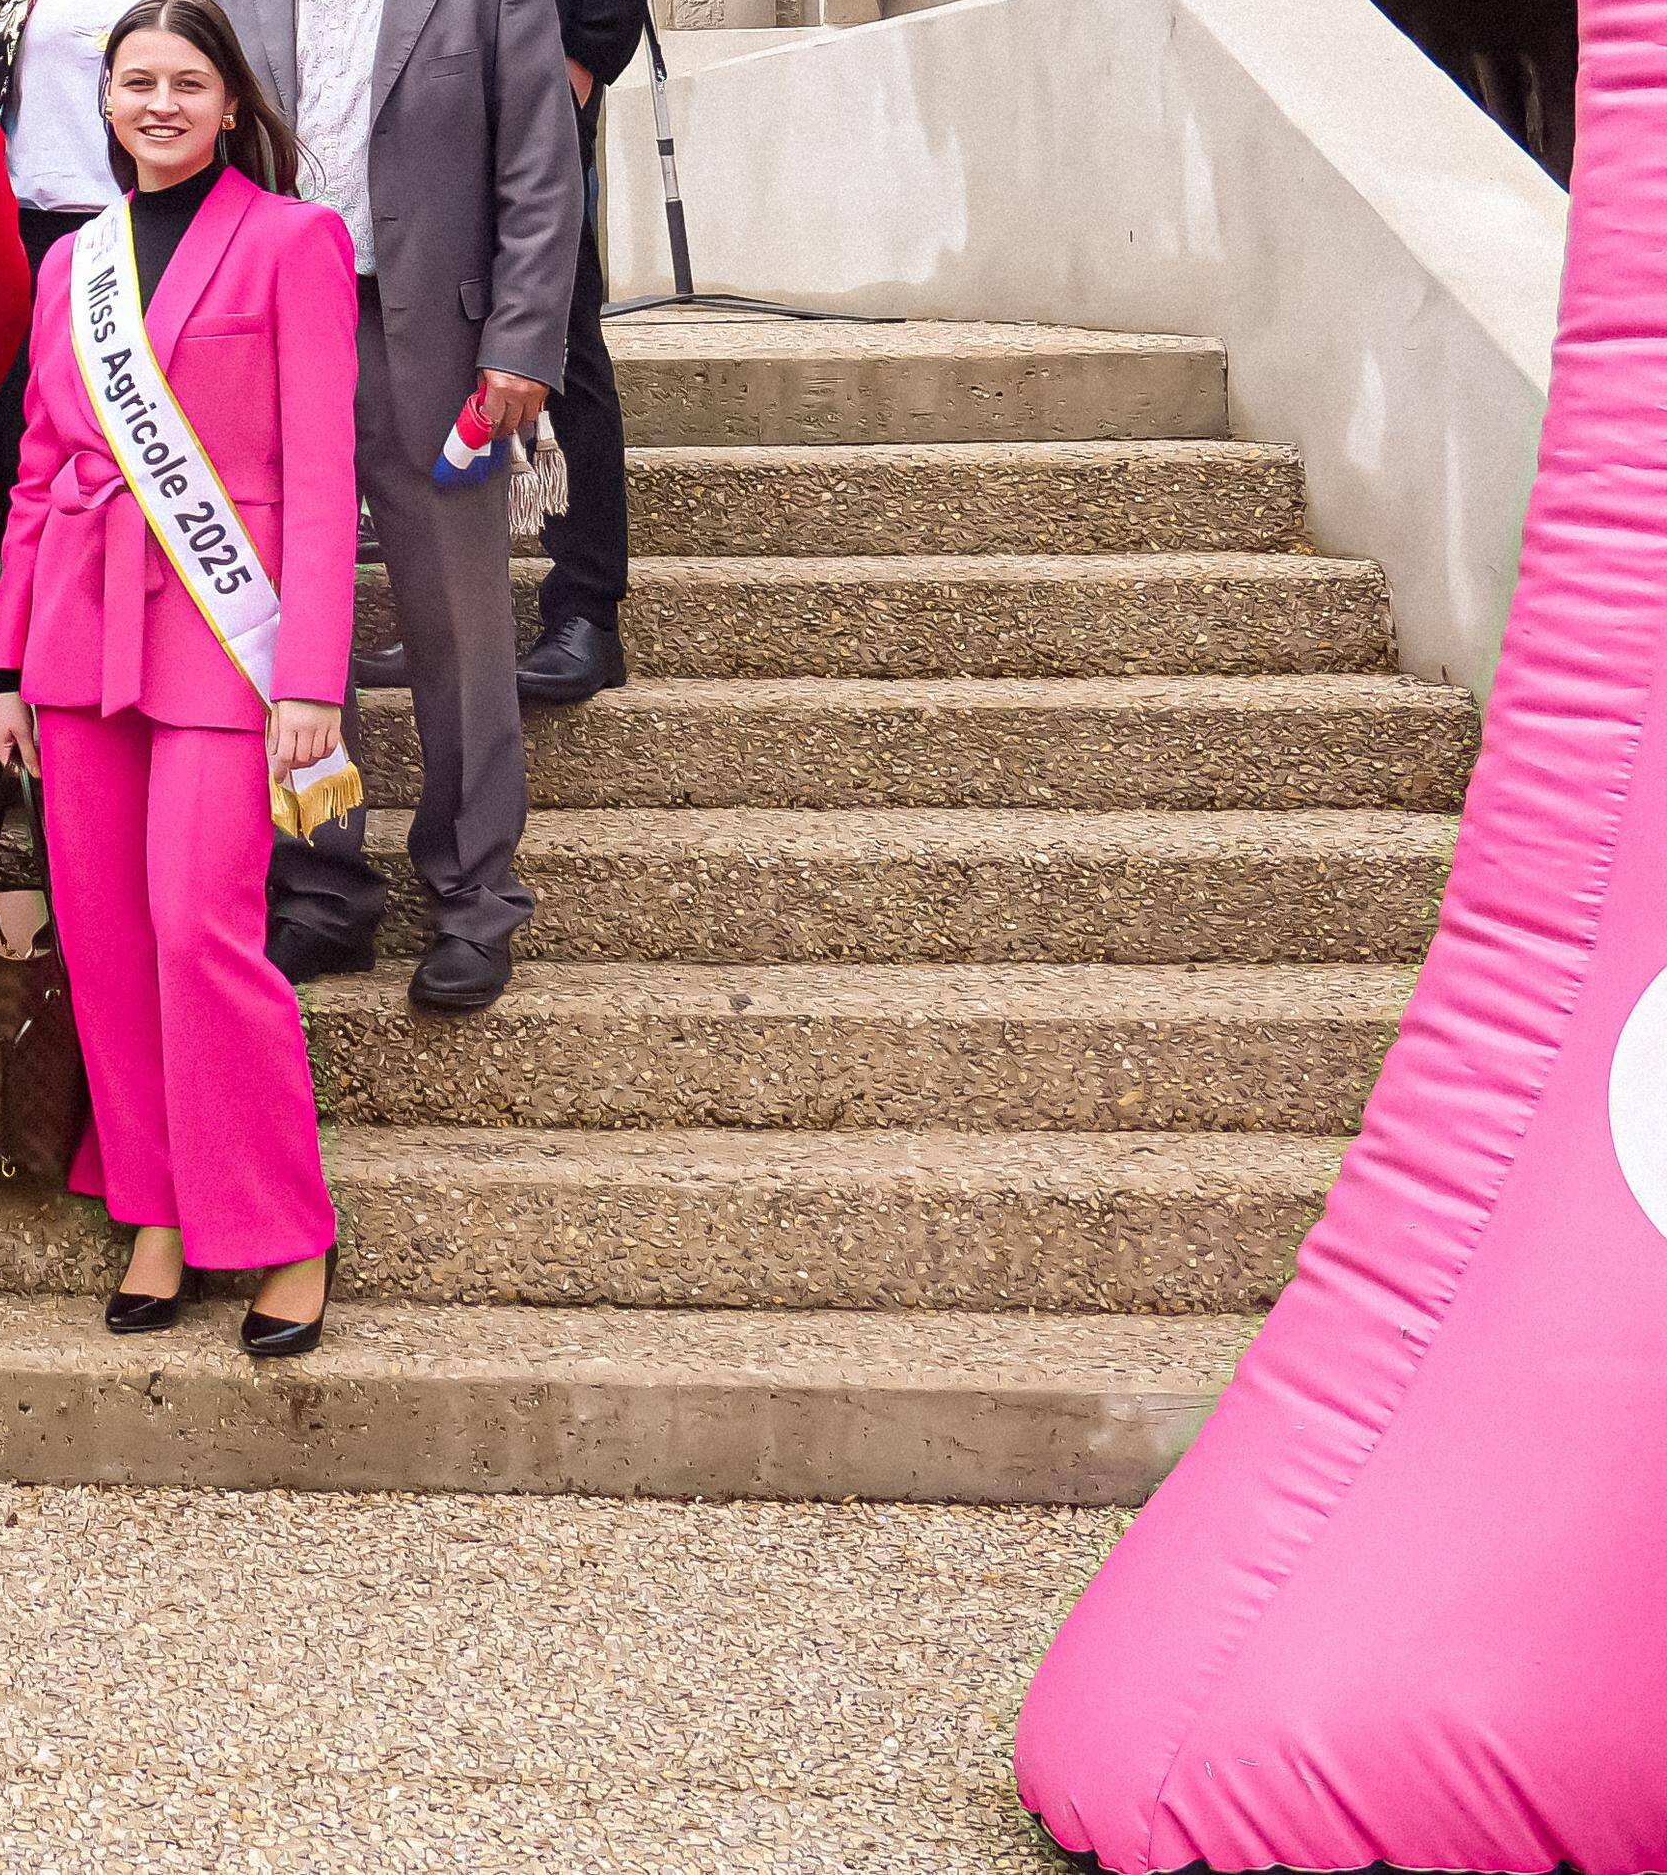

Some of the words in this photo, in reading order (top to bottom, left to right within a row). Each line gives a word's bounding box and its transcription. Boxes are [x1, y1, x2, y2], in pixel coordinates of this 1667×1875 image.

[86, 264, 119, 344] Miss
[101, 347, 188, 500] Agricole
[174, 500, 253, 597] 2025
